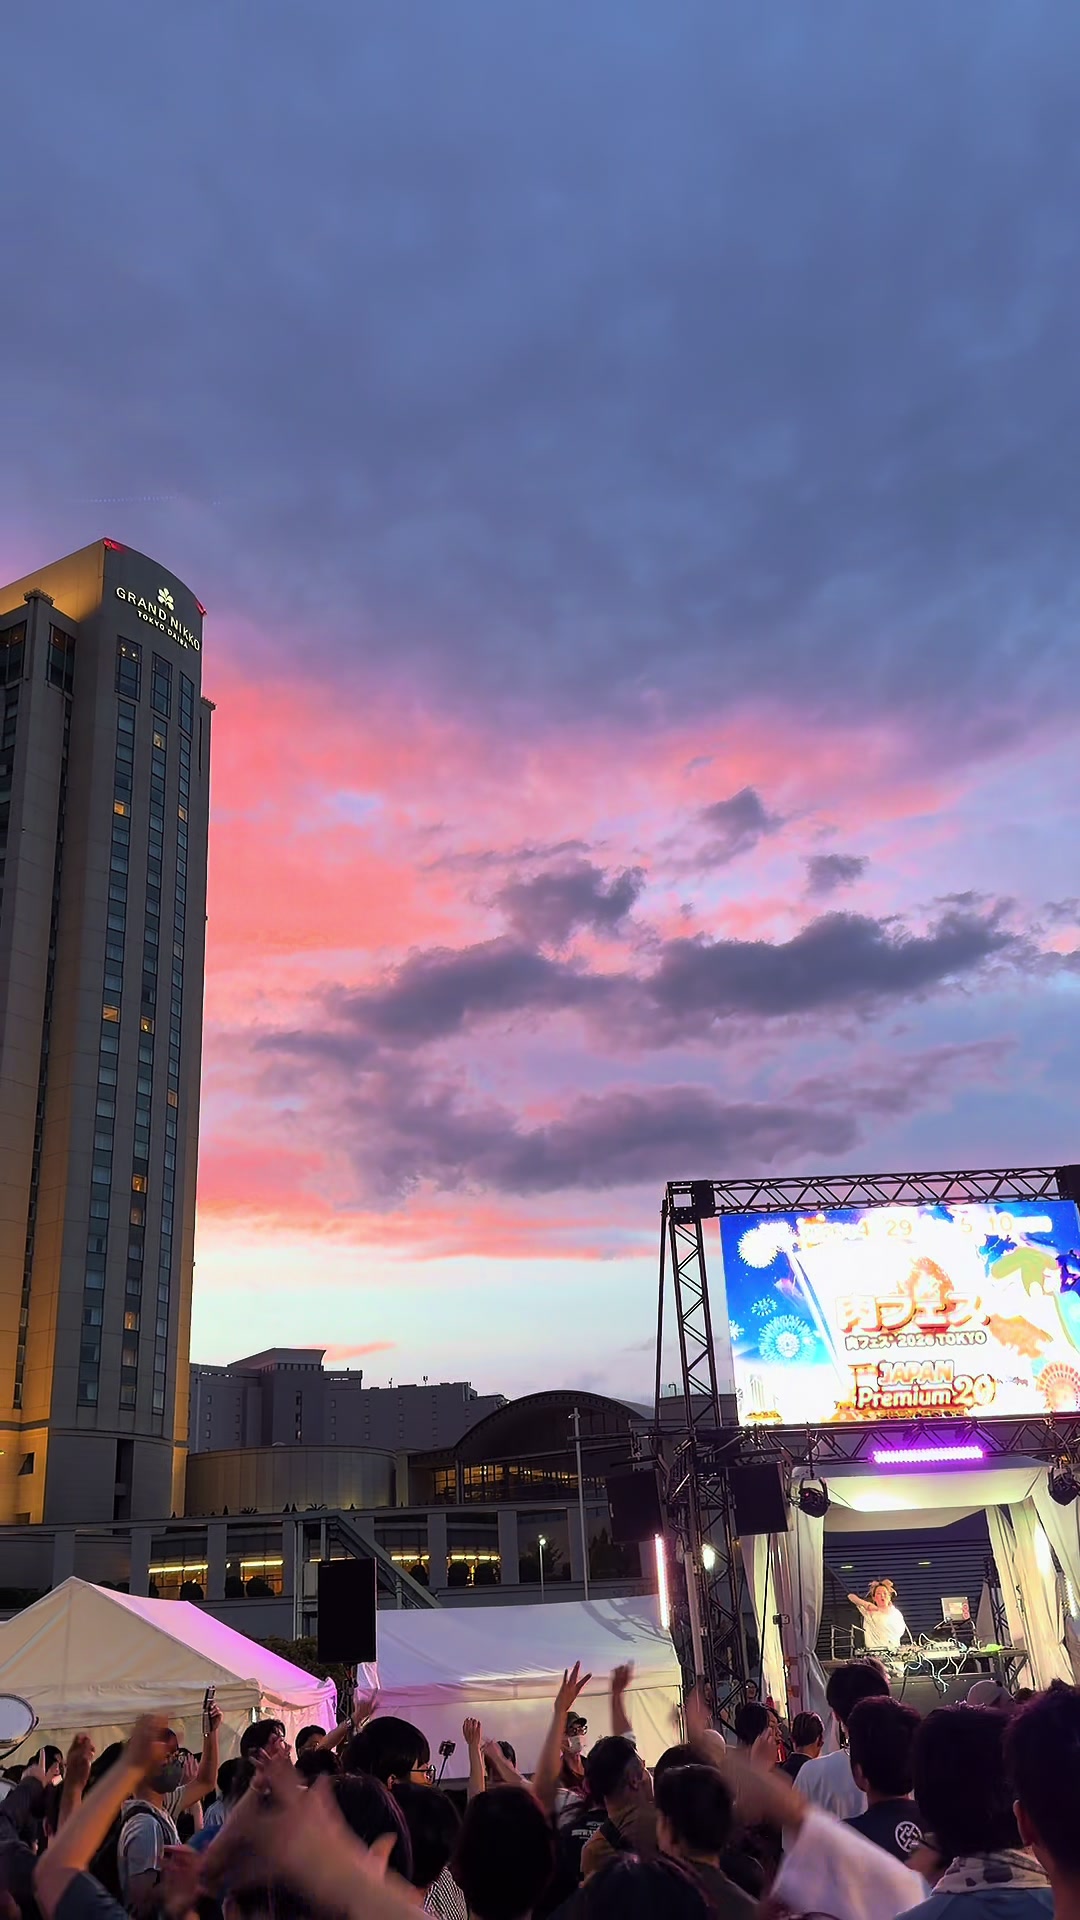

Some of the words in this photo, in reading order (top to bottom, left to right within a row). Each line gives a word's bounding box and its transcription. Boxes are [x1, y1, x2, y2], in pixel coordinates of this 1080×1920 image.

[116, 587, 167, 621] GRAND
[170, 616, 200, 651] NIKKO
[137, 610, 165, 631] TOKYO
[167, 628, 188, 649] DAIBA
[859, 1220, 872, 1237] 4
[885, 1219, 913, 1236] 29
[989, 1214, 1013, 1232] 10
[836, 1294, 991, 1332] 肉フェス
[935, 1331, 988, 1346] TOKYO
[877, 1360, 954, 1386] JAPAN
[857, 1384, 953, 1409] Premium
